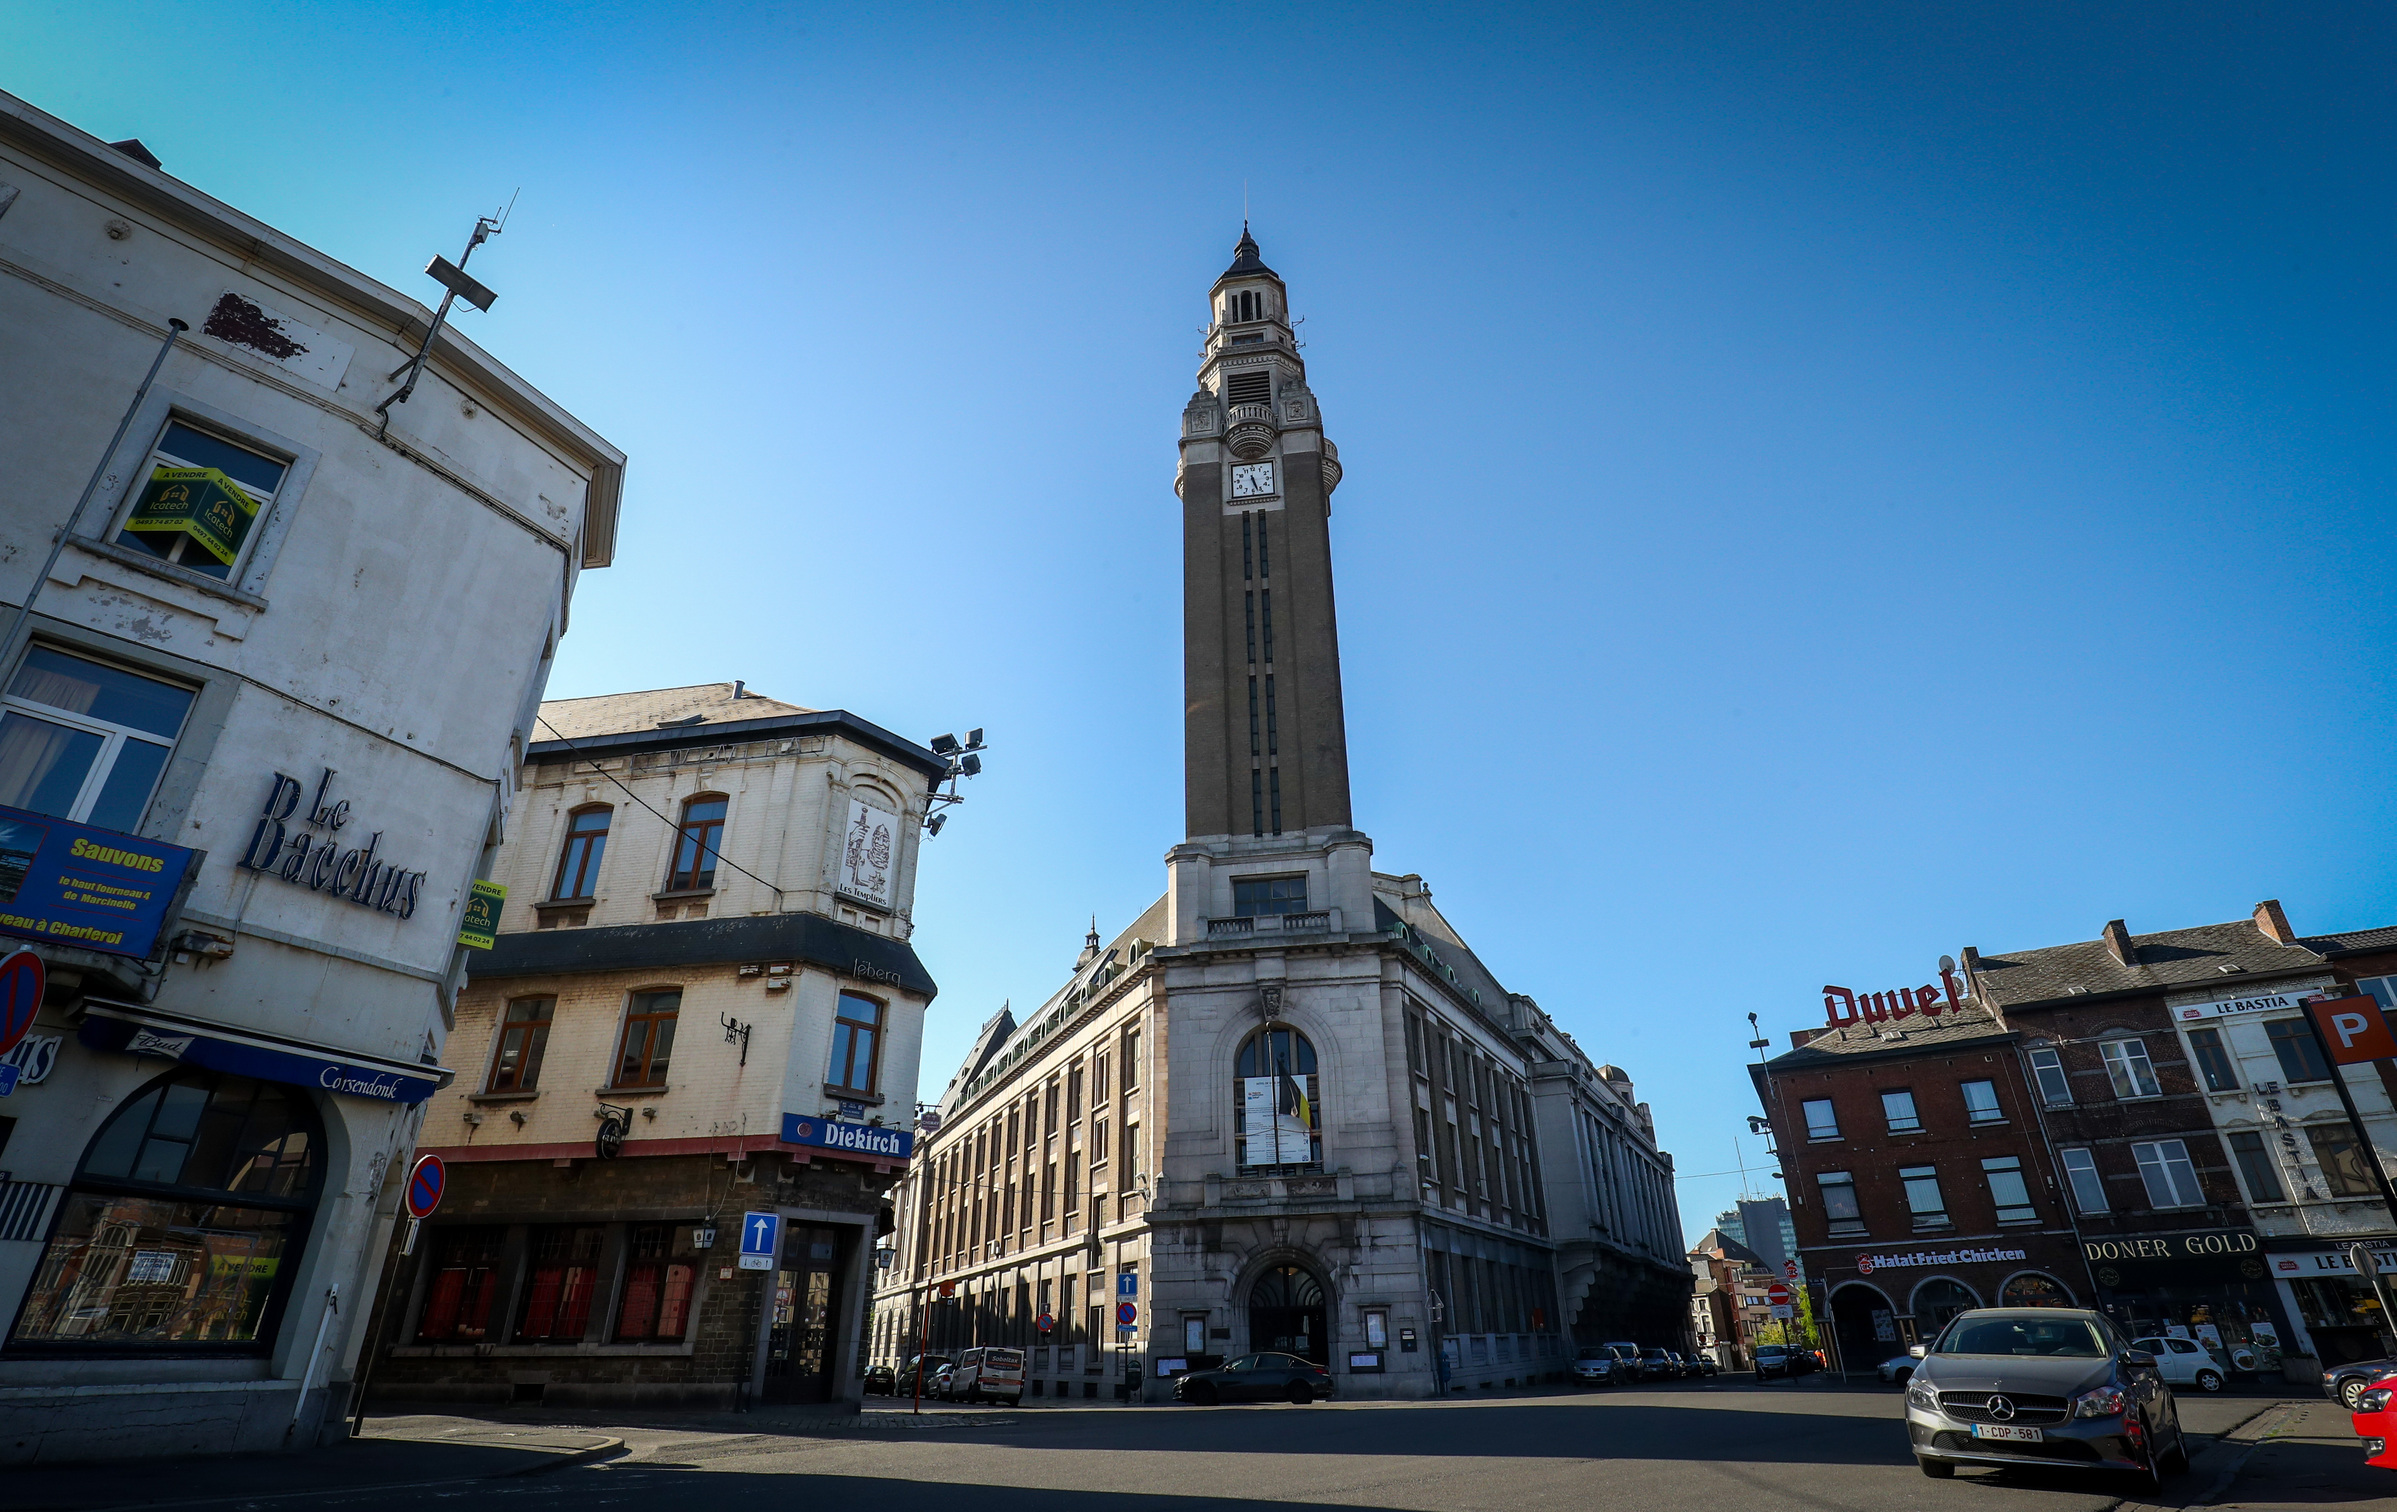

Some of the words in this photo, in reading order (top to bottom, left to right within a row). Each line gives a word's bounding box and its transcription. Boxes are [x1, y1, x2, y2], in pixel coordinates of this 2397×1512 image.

[223, 484, 250, 509] VENDRE
[192, 525, 207, 539] 0497
[220, 549, 229, 557] 24
[307, 767, 350, 830] Le
[71, 838, 165, 873] Sauvons
[237, 771, 428, 920] Bacchus
[59, 876, 70, 886] le
[71, 878, 96, 891] haut
[97, 882, 143, 899] fourneau
[143, 891, 151, 901] 4
[63, 891, 77, 901] de
[81, 894, 137, 911] Marcinelle
[36, 918, 48, 932] à
[49, 921, 124, 945] Charleroi
[1822, 969, 1962, 1030] Duvel
[2216, 1004, 2234, 1015] LE
[2237, 997, 2289, 1012] BASTIA
[138, 1035, 182, 1052] Bud
[2331, 1012, 2369, 1049] P
[320, 1066, 404, 1099] Corsendonk
[2254, 1081, 2281, 1096] LE
[825, 1123, 900, 1155] Diekirch
[2266, 1099, 2321, 1201] BASTIA
[1916, 1250, 1957, 1267] Fried
[1959, 1247, 2027, 1264] Chicken
[2085, 1239, 2173, 1261] DONER
[2185, 1234, 2257, 1255] GOLD
[2335, 1242, 2350, 1250] LE
[2314, 1255, 2340, 1270] LE
[2341, 1252, 2397, 1269] BSTI
[1979, 1426, 2041, 1440] 1-CDP-581
